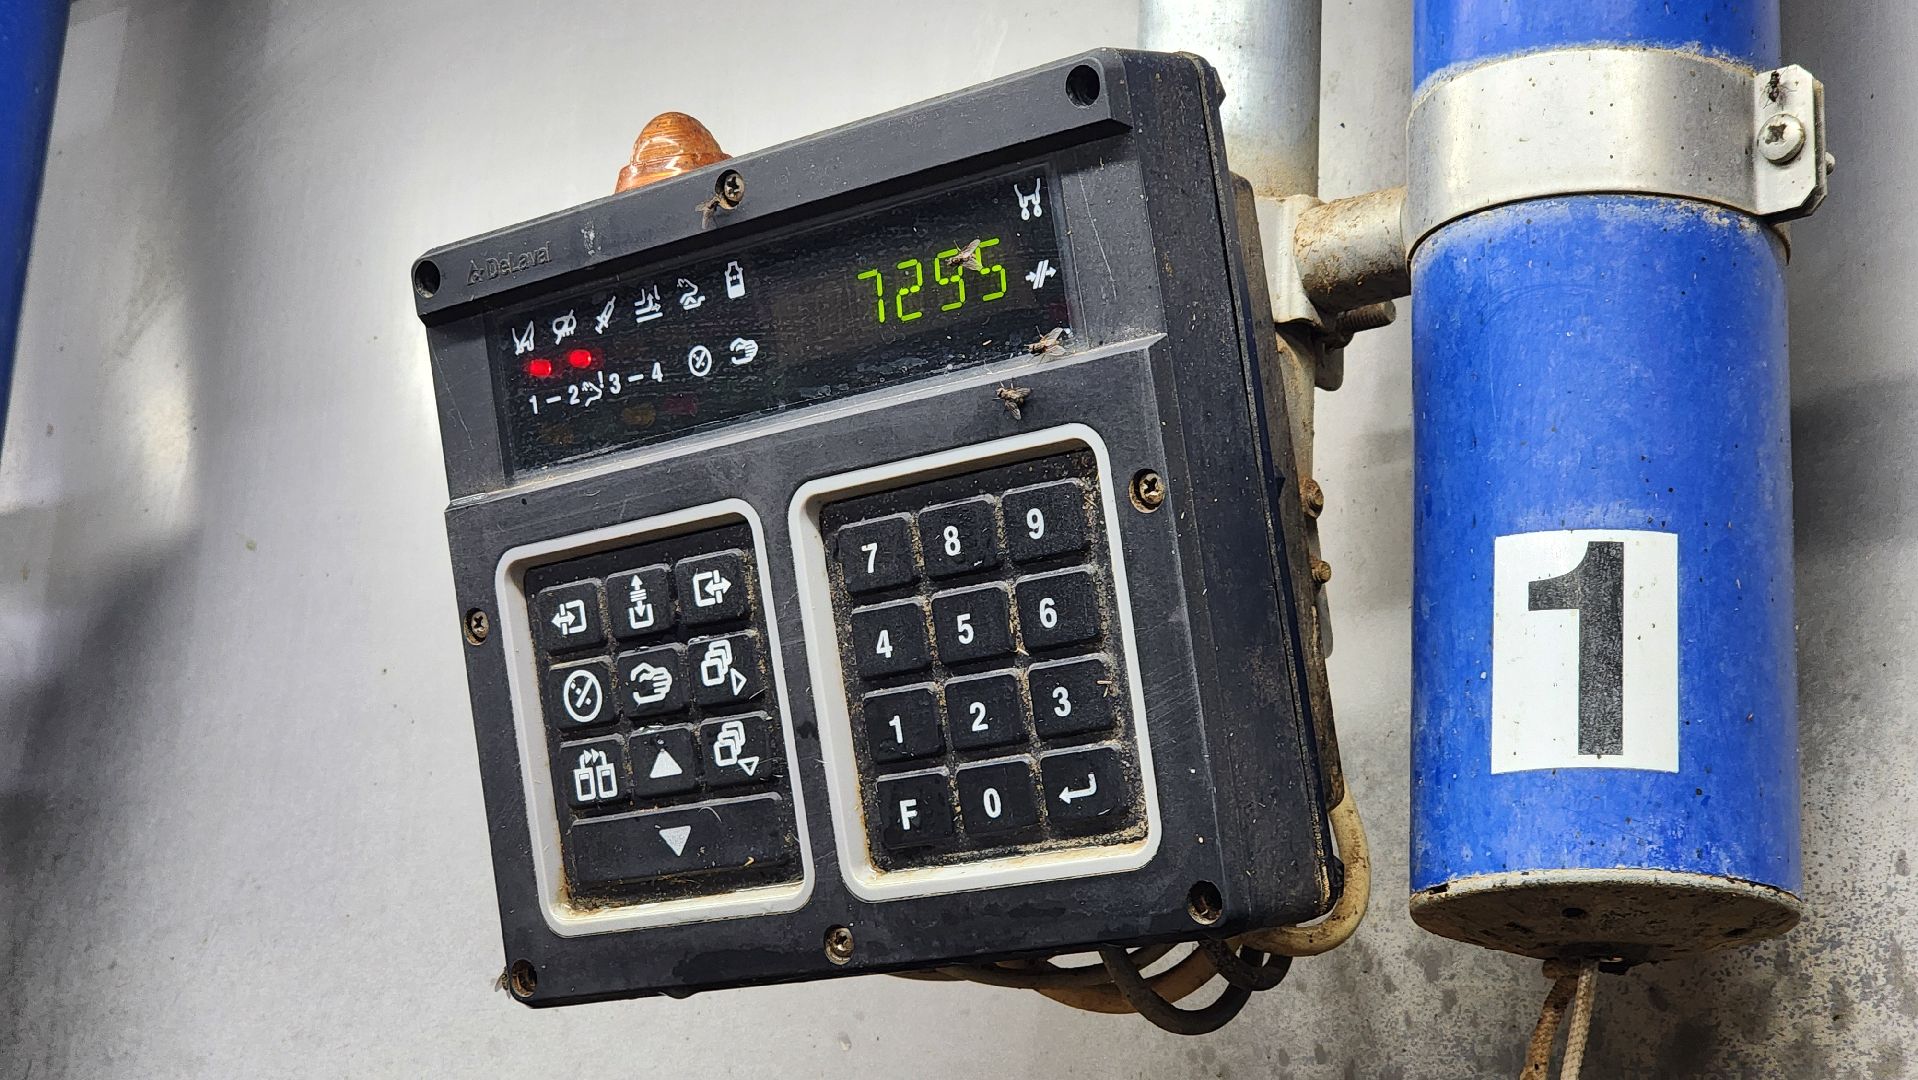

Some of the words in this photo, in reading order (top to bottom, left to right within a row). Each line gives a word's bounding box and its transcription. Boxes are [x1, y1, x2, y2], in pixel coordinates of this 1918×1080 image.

[485, 240, 551, 280] DeLaval
[857, 237, 1007, 323] 7295
[1026, 507, 1045, 540] 9
[943, 525, 962, 557] 8
[861, 542, 878, 574] 7
[956, 613, 975, 645] 5
[1039, 597, 1058, 629] 6
[876, 629, 893, 659] 4
[1528, 541, 1624, 755] 1
[969, 701, 989, 732] 2
[1052, 686, 1072, 717] 3
[888, 715, 904, 744] 1
[899, 798, 918, 831] F
